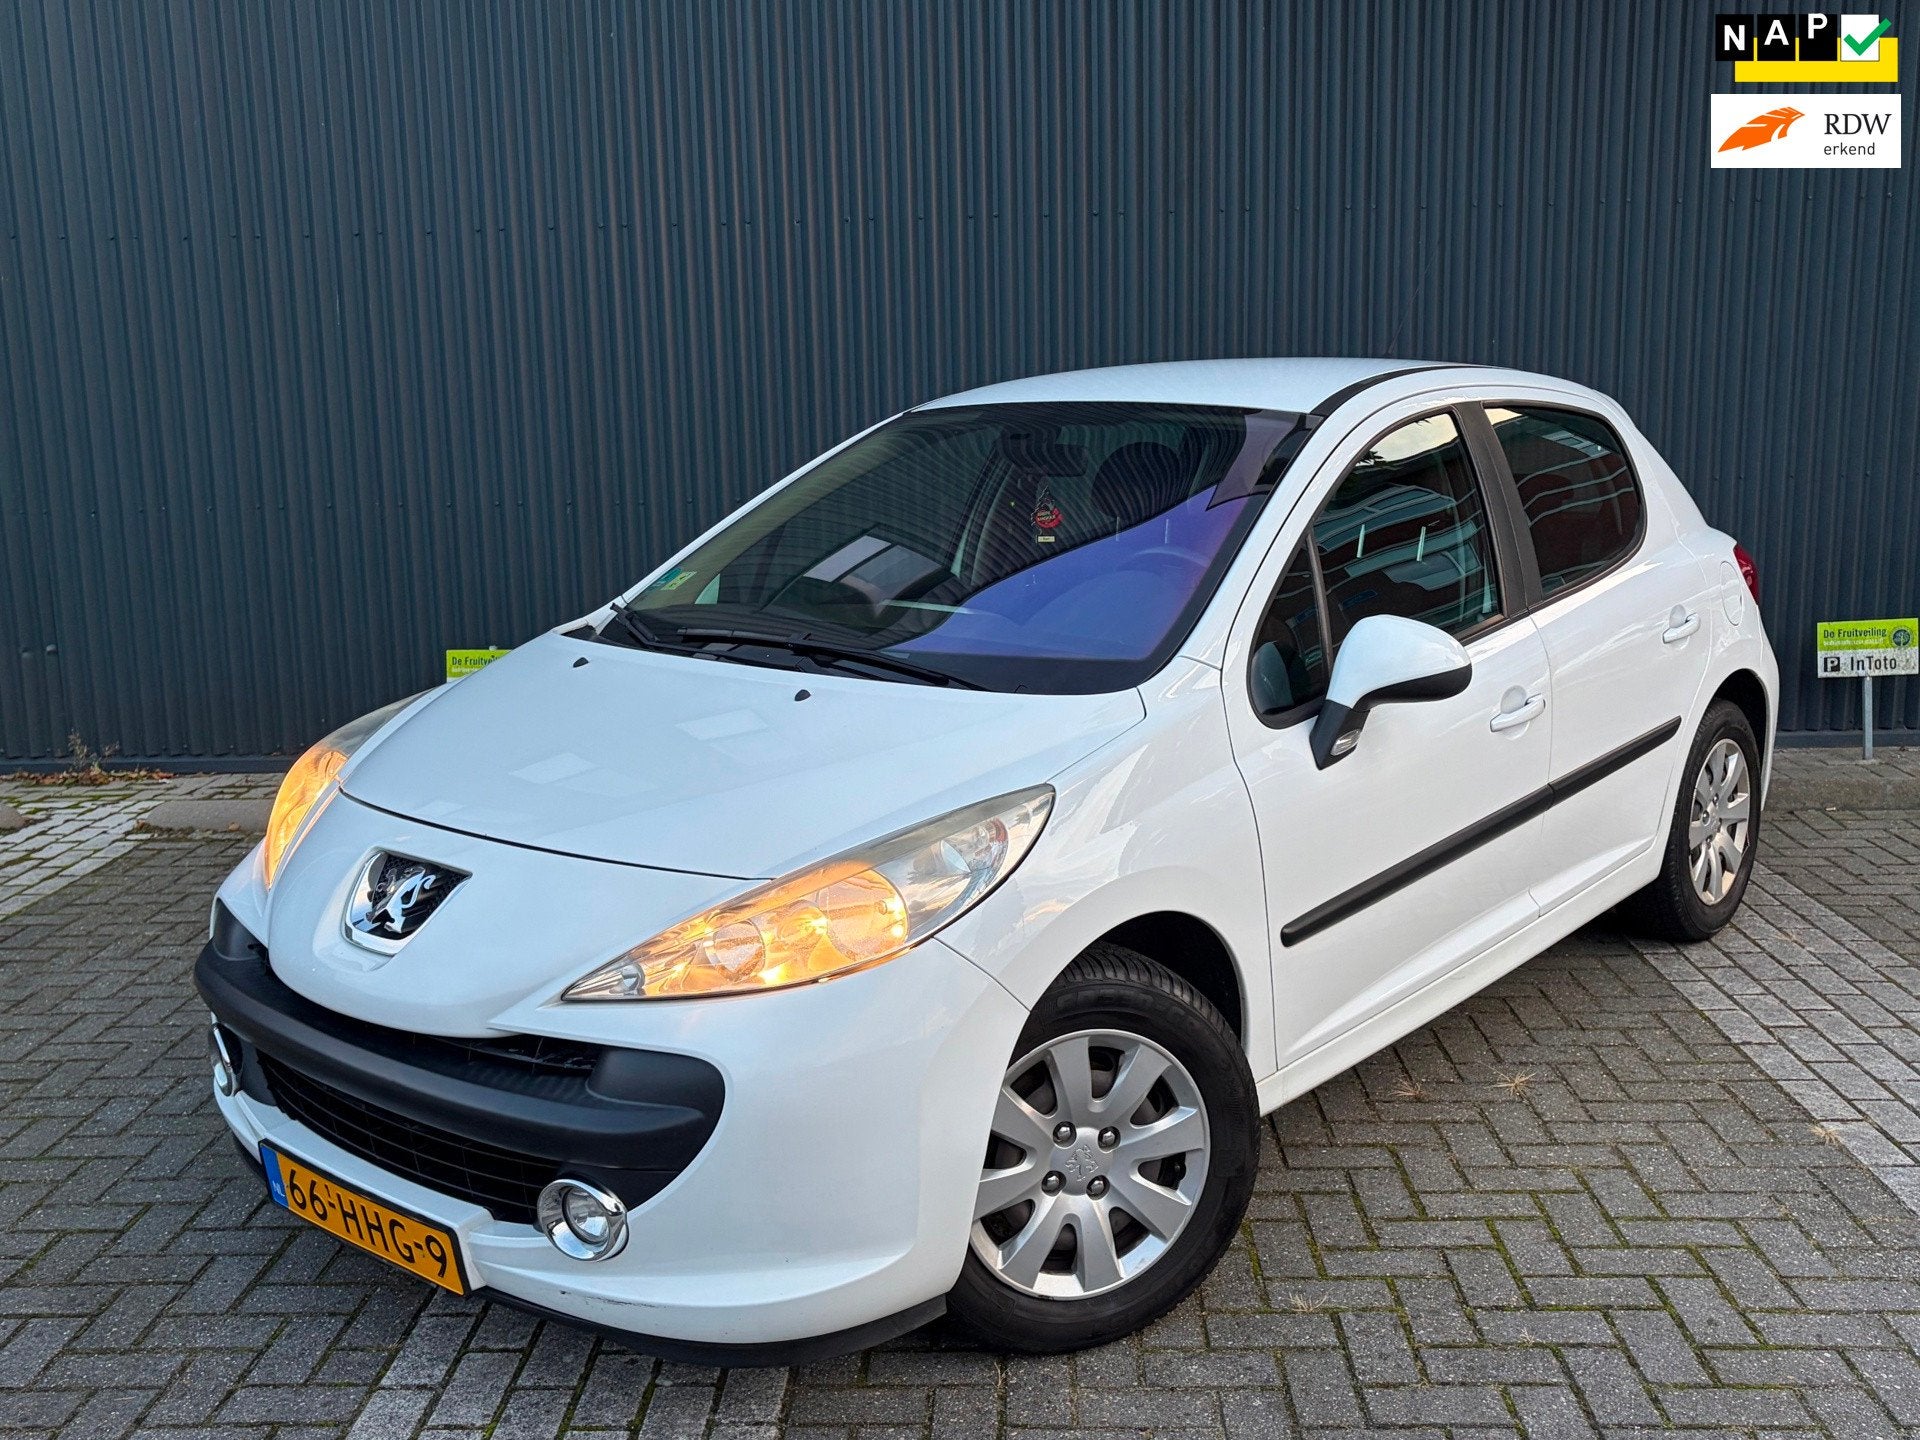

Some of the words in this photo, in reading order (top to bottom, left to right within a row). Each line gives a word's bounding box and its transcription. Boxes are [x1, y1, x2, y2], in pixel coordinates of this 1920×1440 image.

[1838, 627, 1886, 637] Fruitveiling
[452, 656, 462, 665] De
[1851, 656, 1897, 671] InToto
[289, 1168, 448, 1279] 66-HHG-9
